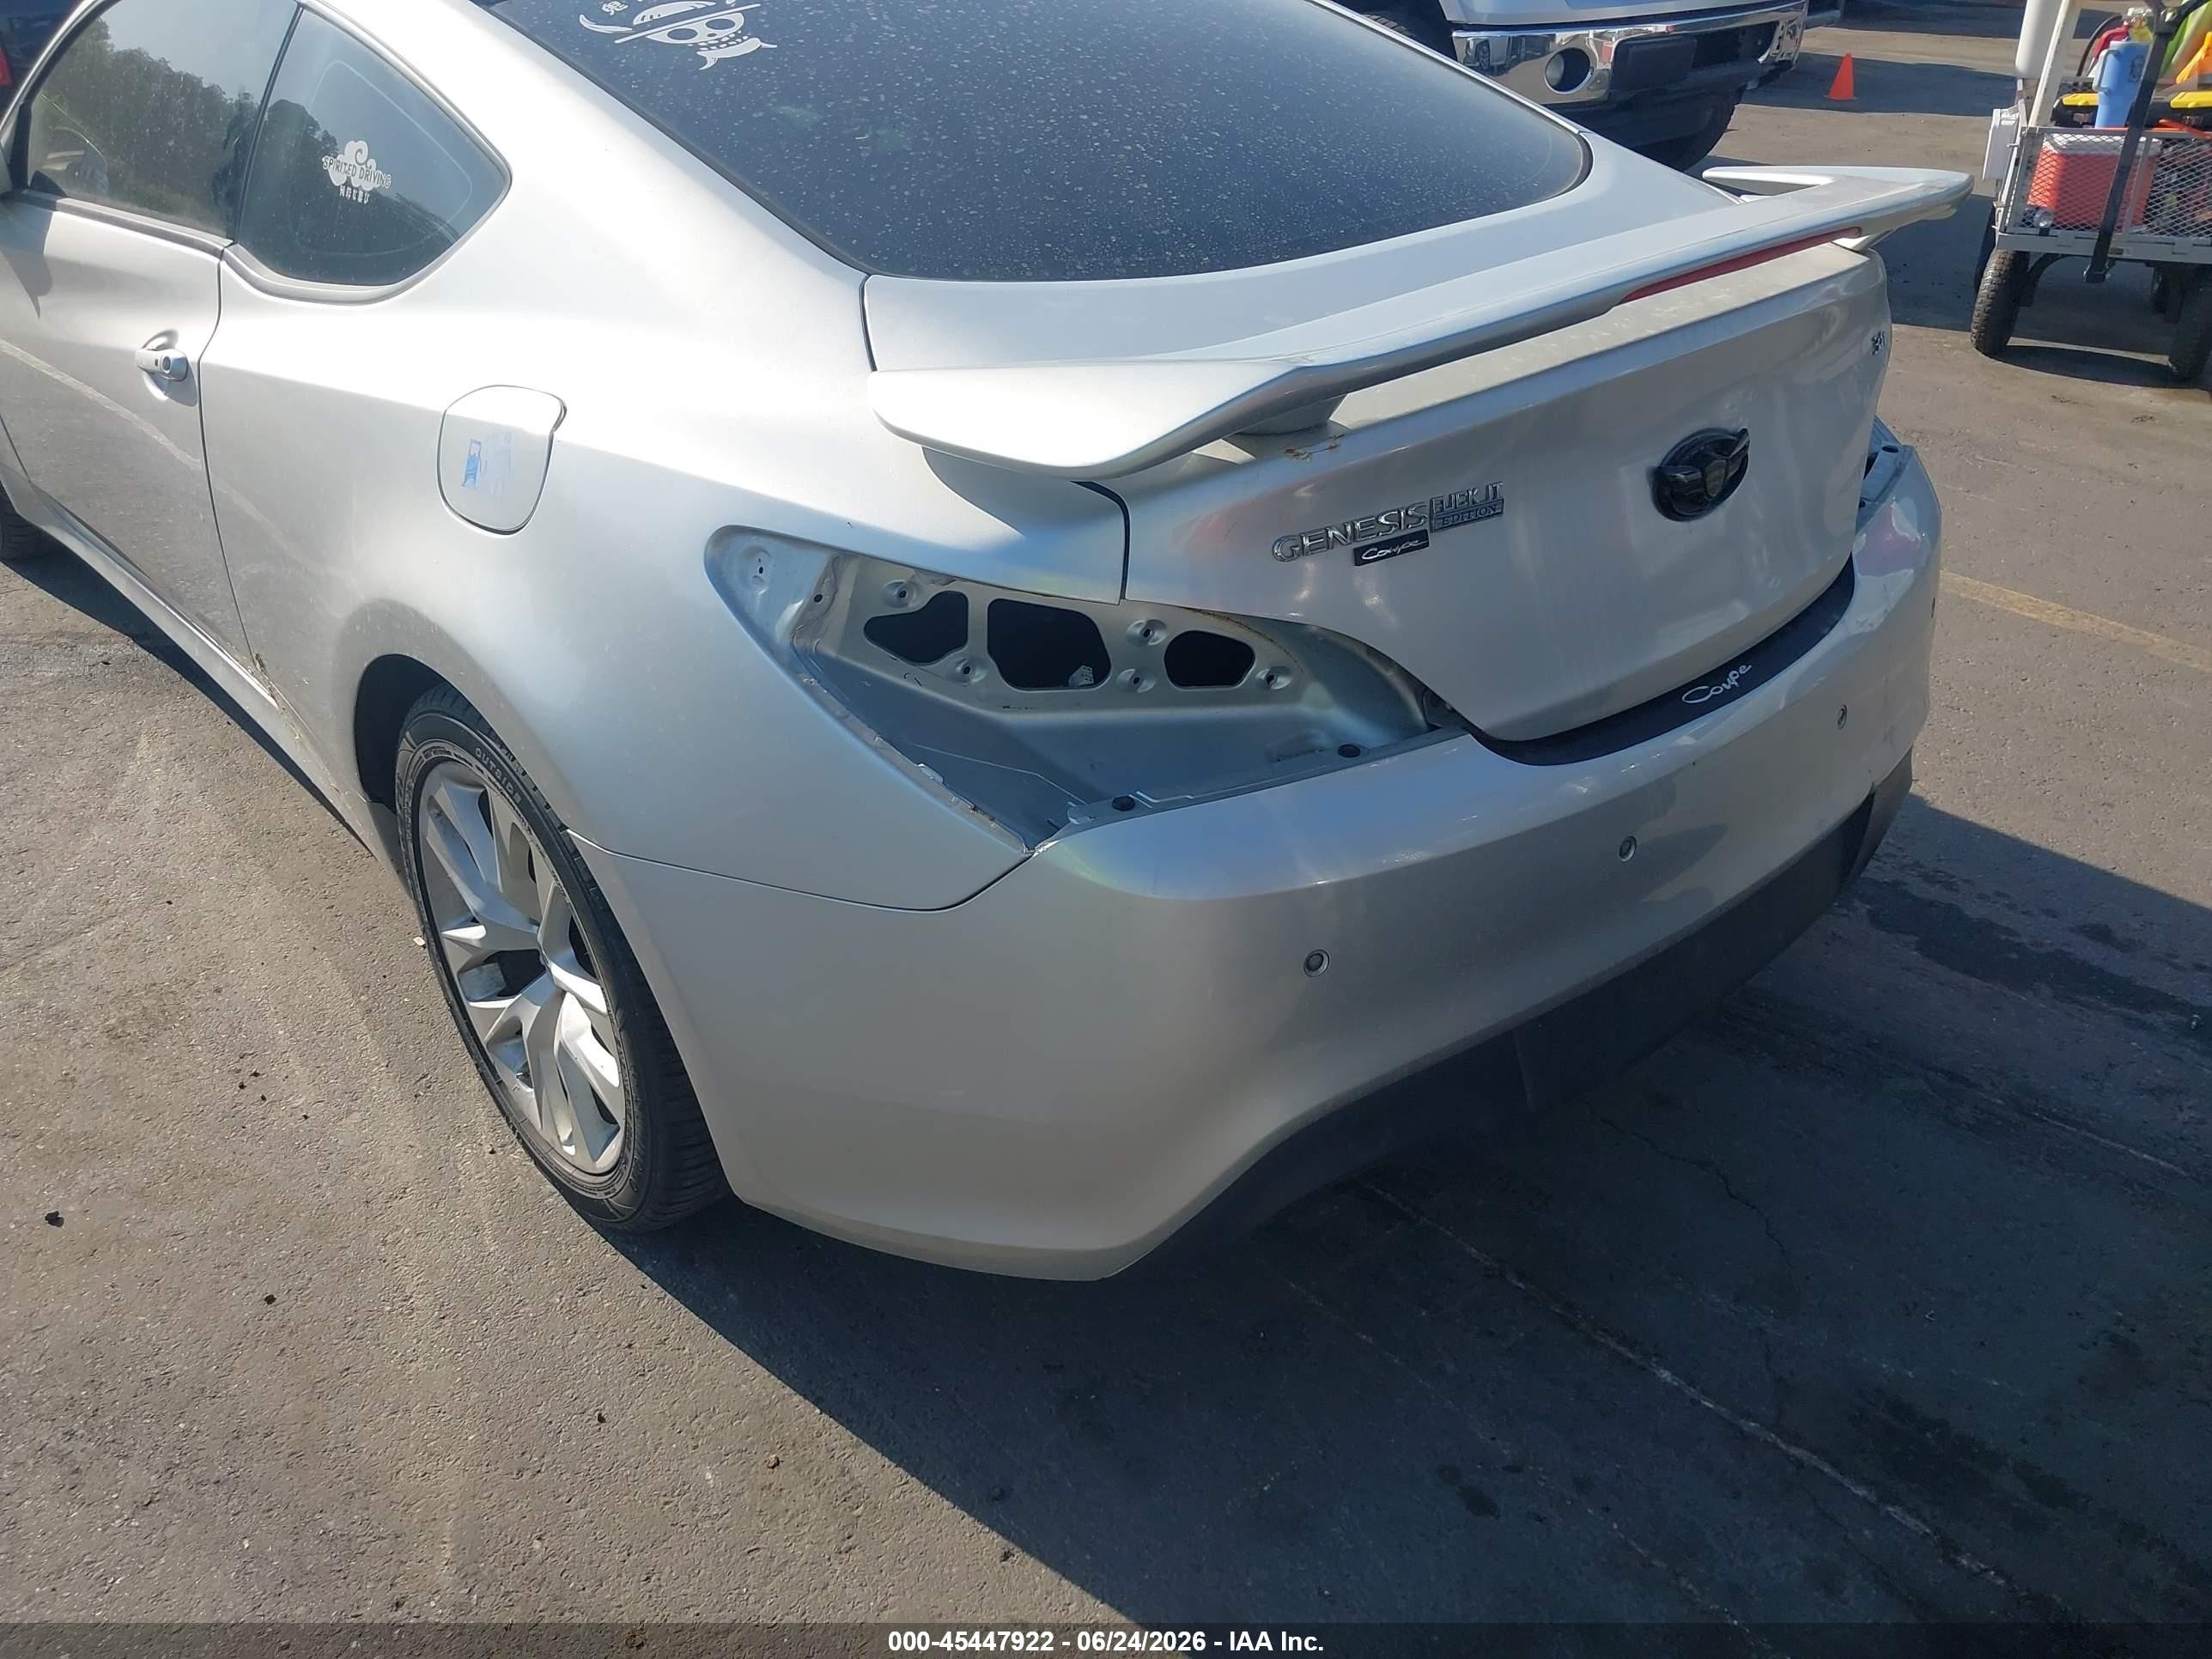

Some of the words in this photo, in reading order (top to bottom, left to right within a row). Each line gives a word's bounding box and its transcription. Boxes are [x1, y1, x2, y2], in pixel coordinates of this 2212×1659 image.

[322, 155, 357, 177] SPIRITED
[358, 167, 392, 188] DRIVING
[1271, 501, 1429, 562] GENESIS
[1442, 505, 1498, 526] EDITION
[1361, 539, 1427, 560] Coupe
[1681, 665, 1752, 703] Coupe
